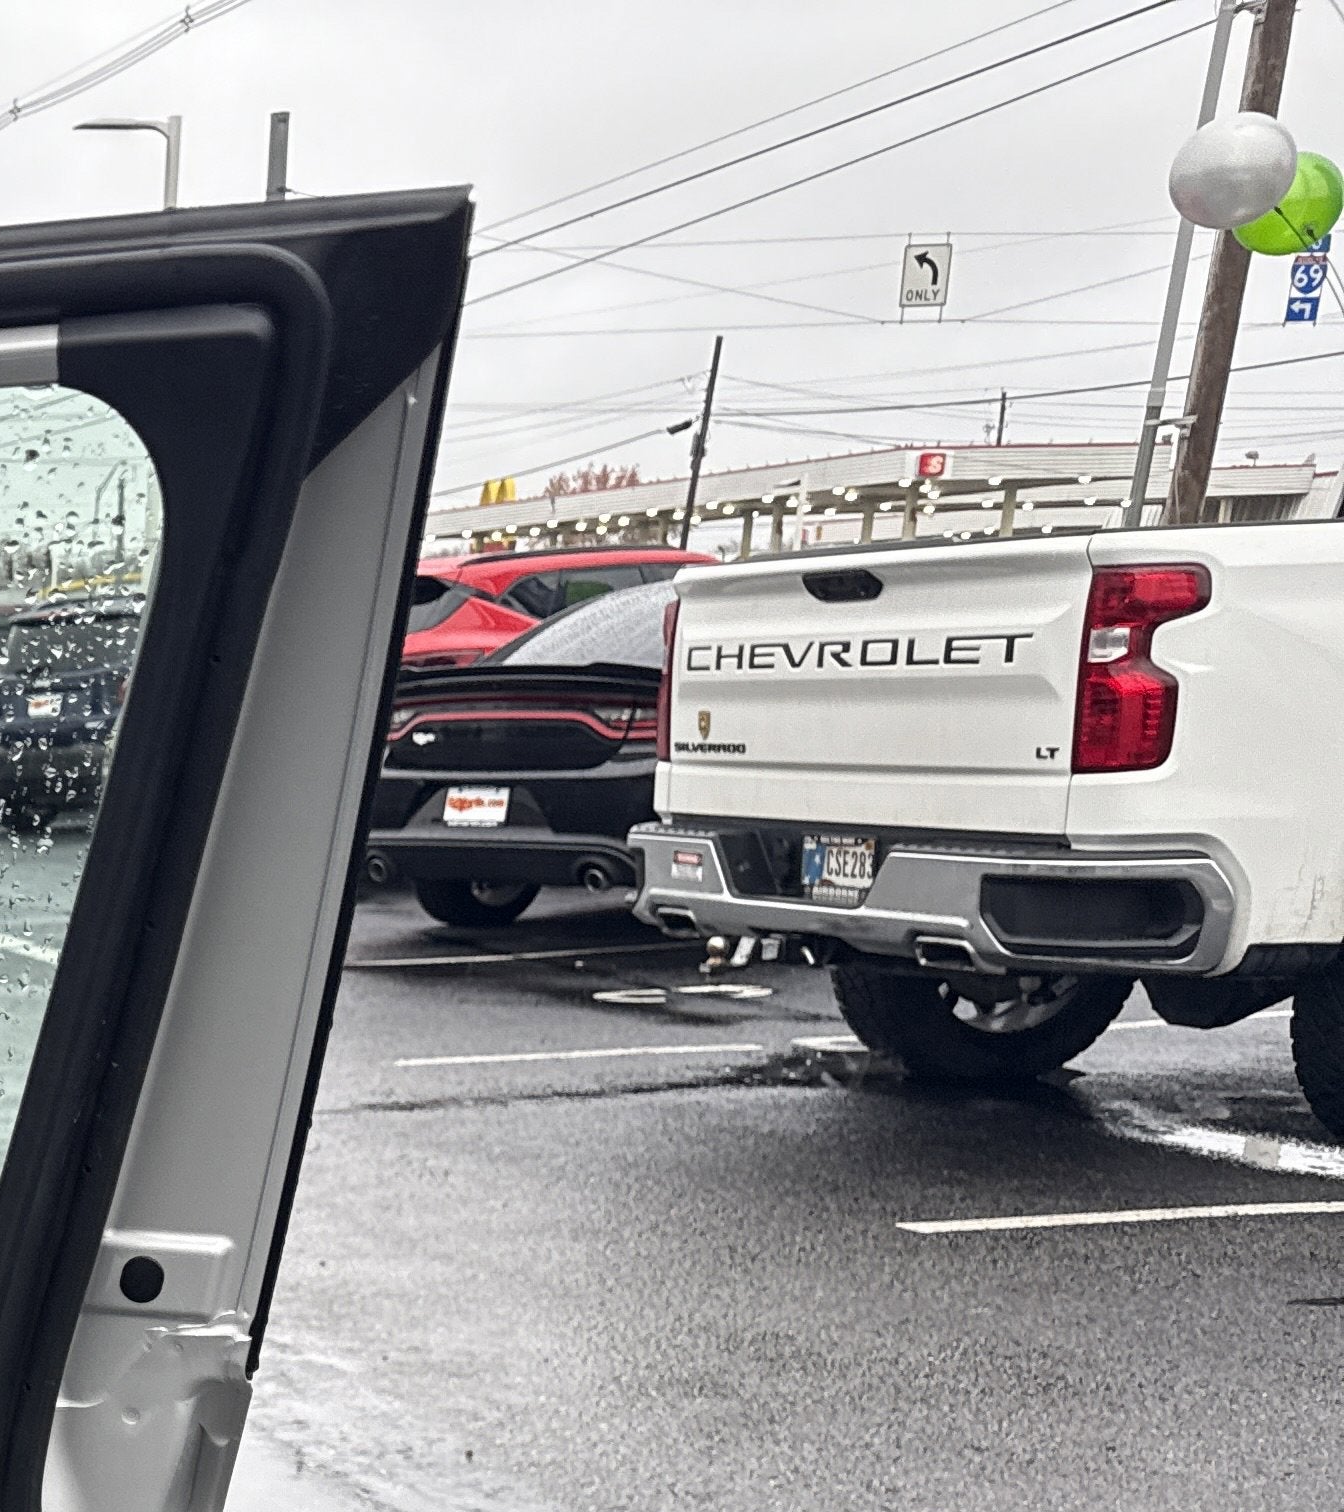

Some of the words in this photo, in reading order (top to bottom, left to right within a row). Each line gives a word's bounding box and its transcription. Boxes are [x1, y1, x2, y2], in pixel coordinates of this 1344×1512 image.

[1294, 264, 1323, 288] 69
[905, 288, 940, 302] ONLY
[686, 632, 1034, 672] CHEVROLET
[674, 742, 747, 754] SILVERADO
[1035, 746, 1061, 760] LT
